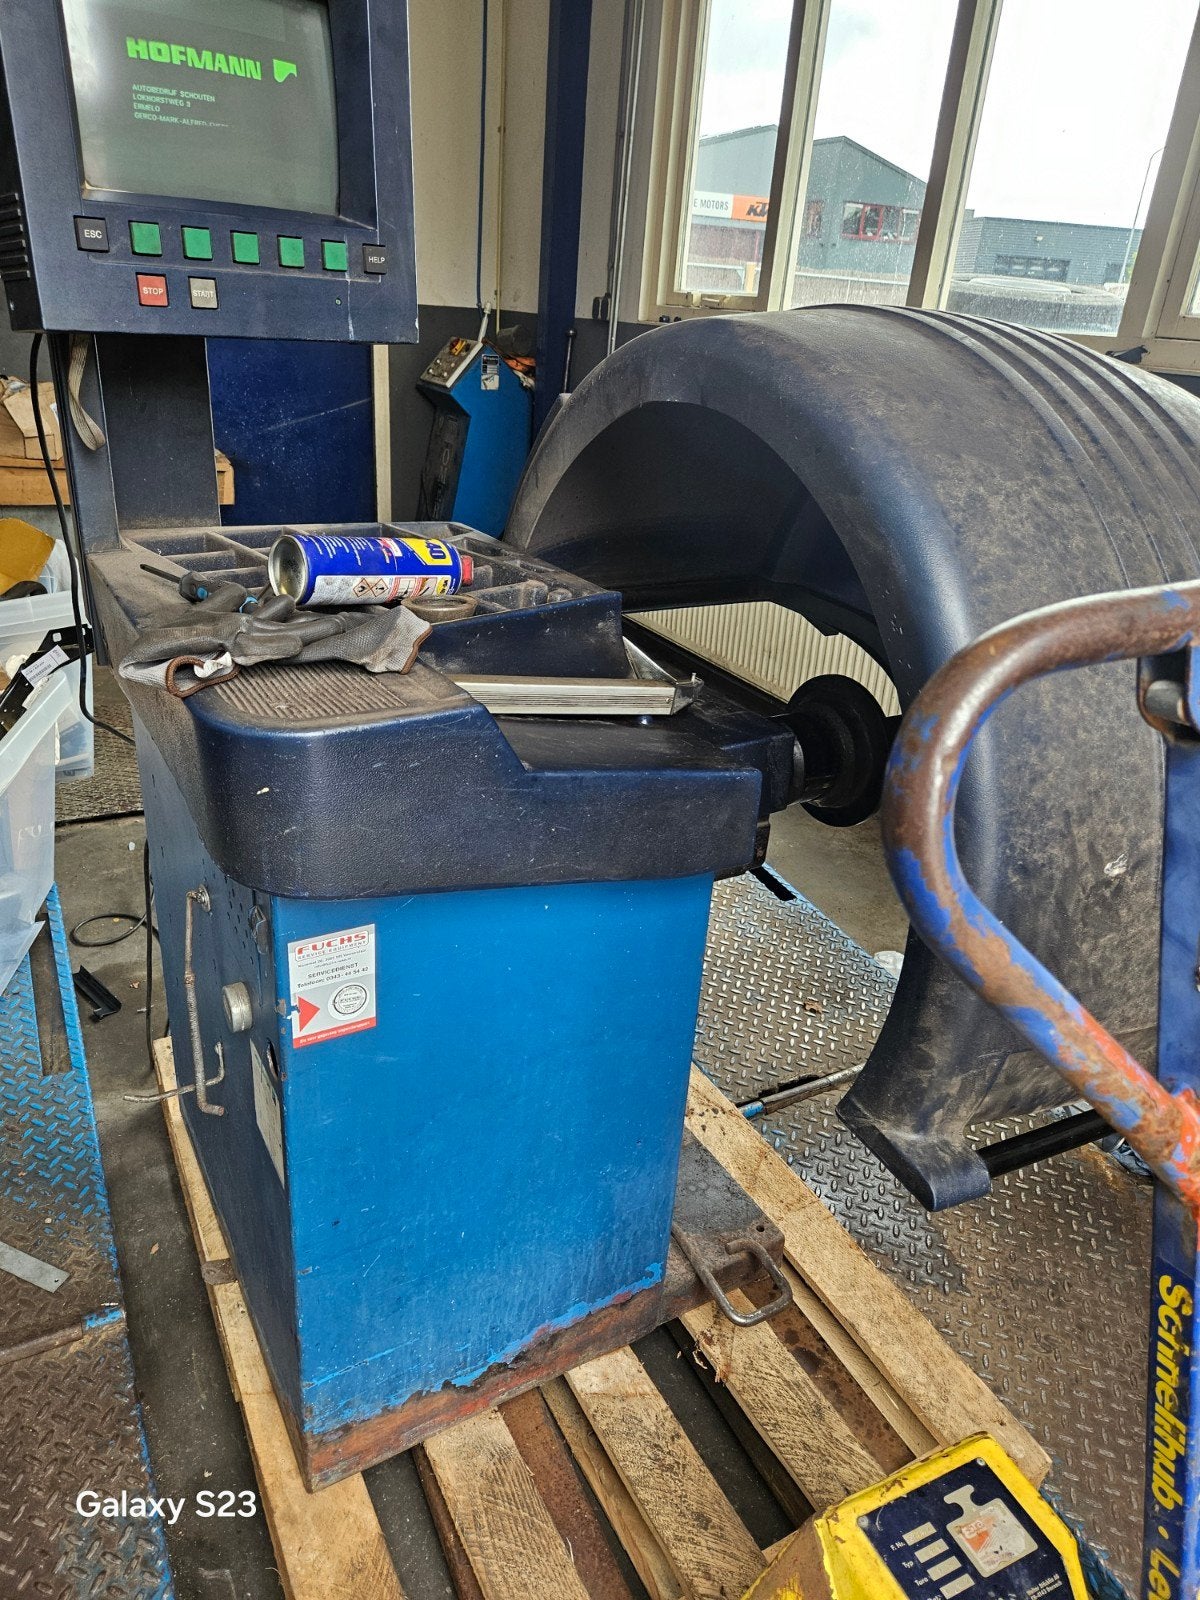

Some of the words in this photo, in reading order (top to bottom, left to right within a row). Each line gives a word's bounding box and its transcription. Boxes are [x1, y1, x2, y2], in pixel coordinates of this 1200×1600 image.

[126, 36, 262, 80] HOFMANN
[179, 90, 216, 103] SCHOUTEN
[700, 199, 729, 211] MOTORS
[84, 229, 103, 239] ESC
[368, 255, 386, 264] HELP
[142, 286, 164, 296] STOP
[192, 289, 214, 299] START
[296, 932, 367, 956] FUCHS
[901, 1559, 914, 1570] Typ
